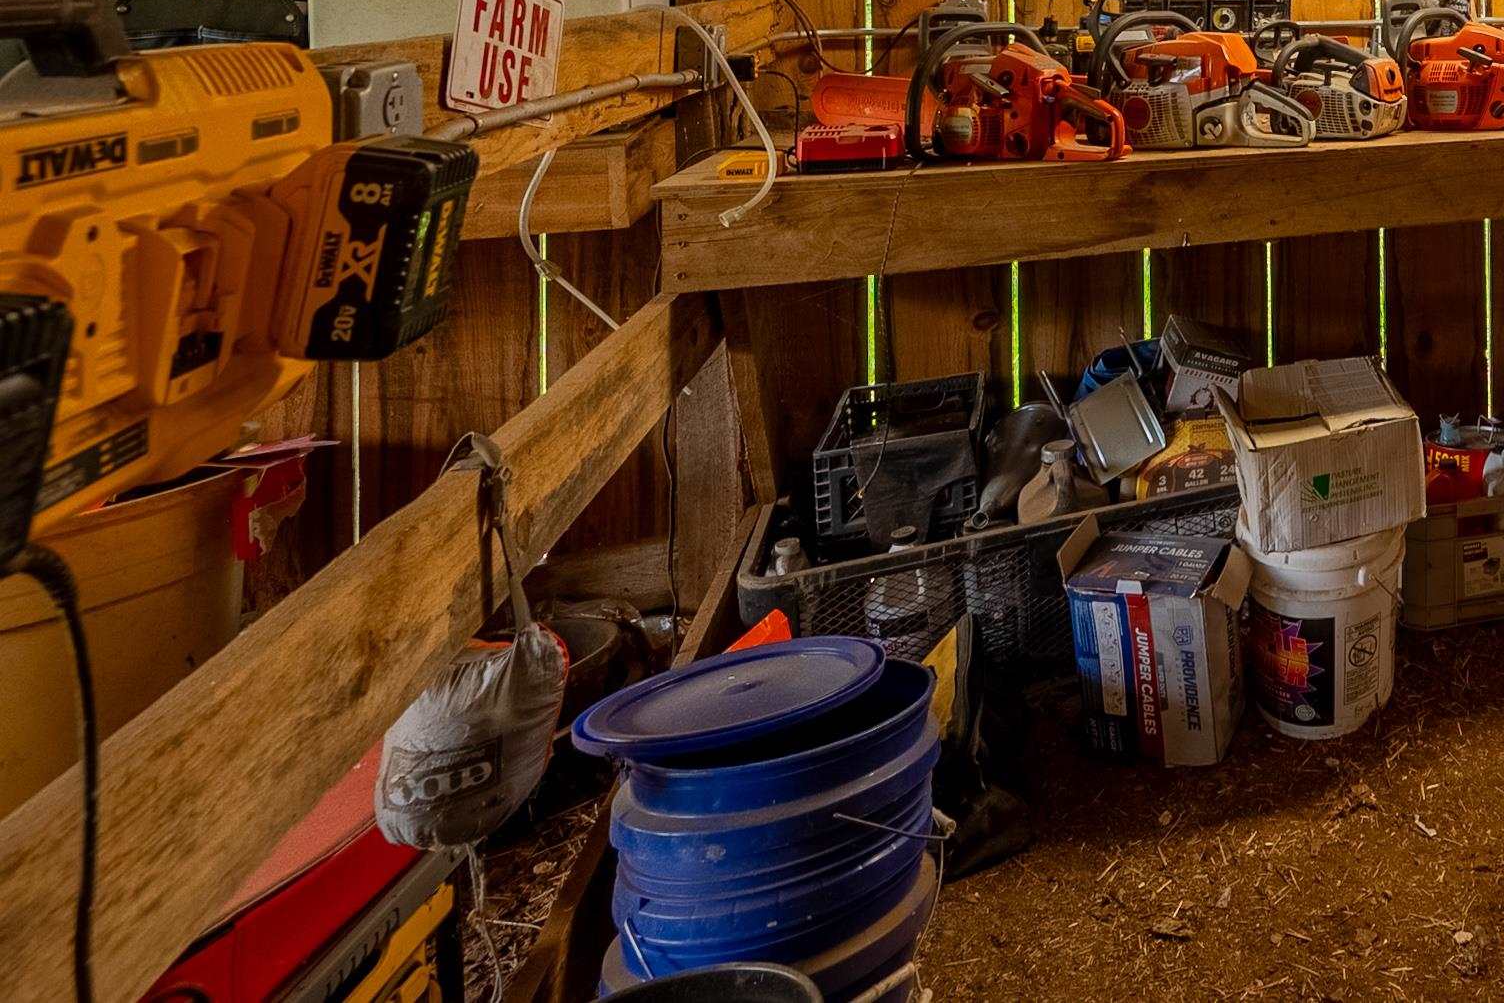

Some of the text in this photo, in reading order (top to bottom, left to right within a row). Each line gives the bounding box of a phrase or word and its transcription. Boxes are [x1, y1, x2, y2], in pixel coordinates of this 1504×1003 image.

[479, 42, 532, 105] USE
[351, 183, 381, 204] 8
[337, 224, 388, 302] XR
[331, 304, 357, 341] 20V
[1158, 475, 1167, 486] 3
[1188, 468, 1204, 479] 42
[1112, 543, 1204, 559] JUMPER CABLES
[1135, 627, 1157, 735] JUMPER CABLES
[1180, 650, 1200, 732] PROVIDENCE
